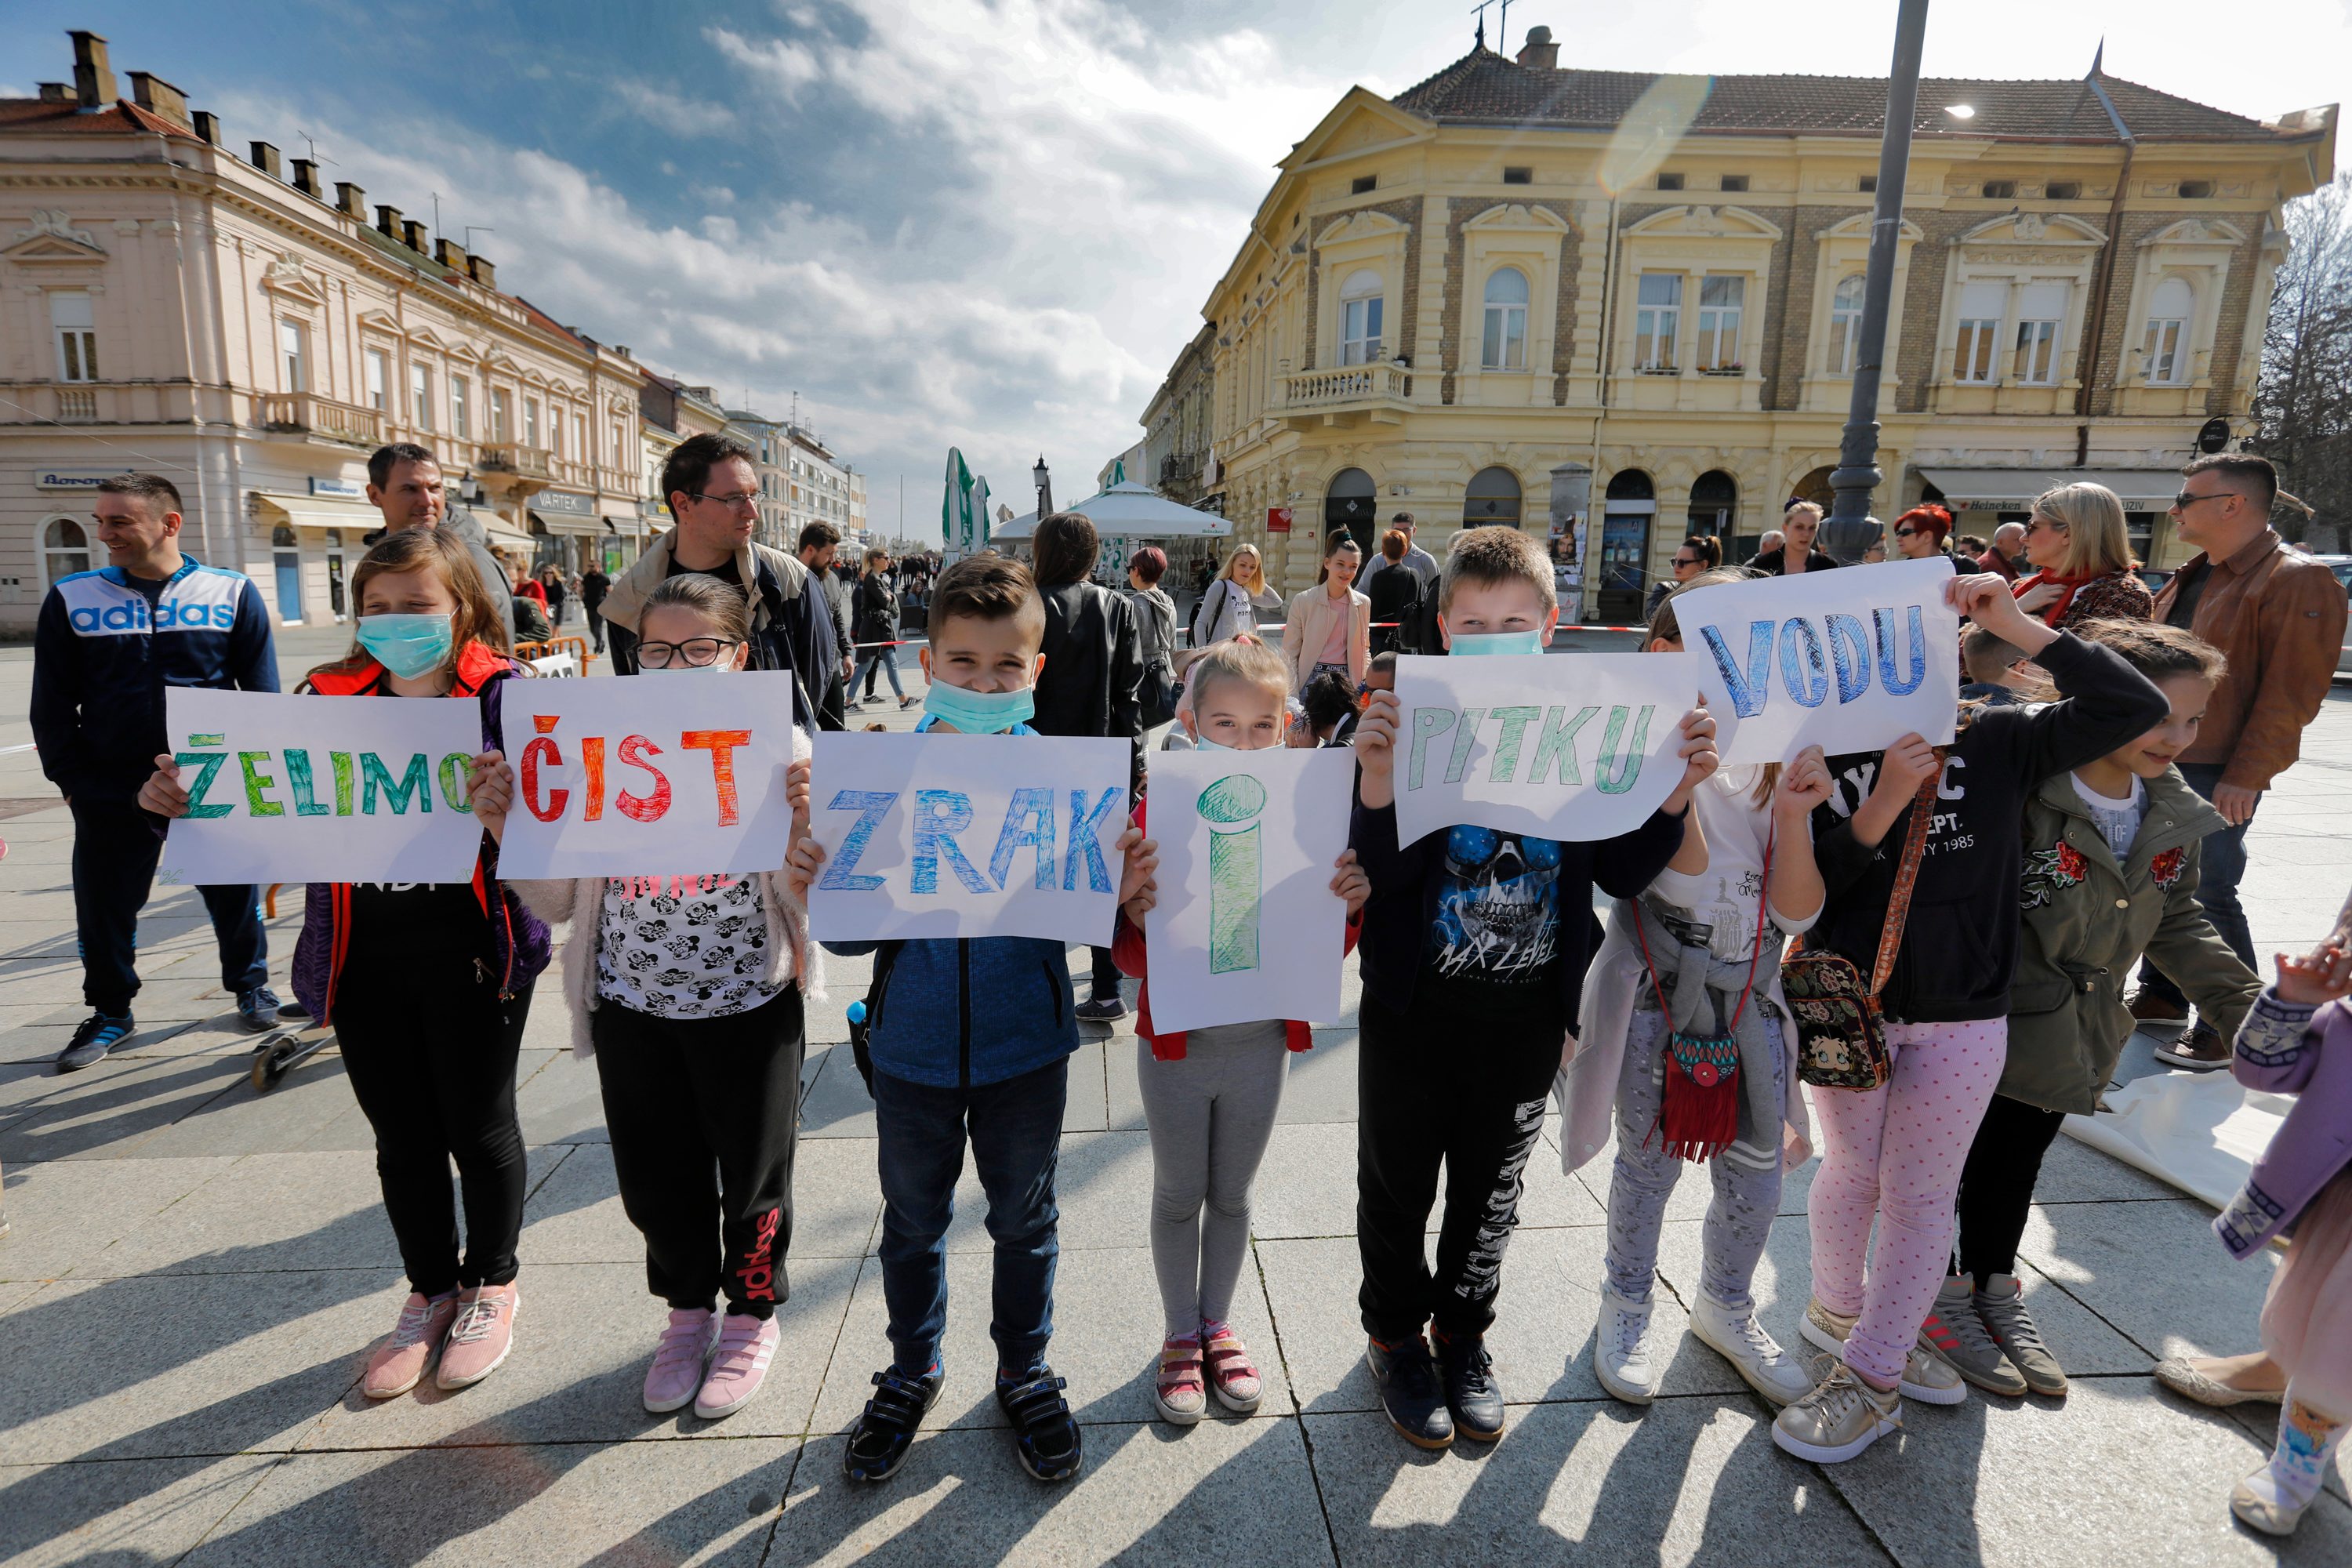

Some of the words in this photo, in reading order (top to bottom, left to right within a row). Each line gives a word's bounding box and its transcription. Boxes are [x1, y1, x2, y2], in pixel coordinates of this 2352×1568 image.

[1970, 501, 2020, 510] Heineken
[71, 598, 234, 632] adidas
[1699, 605, 1926, 719] VODU
[174, 733, 477, 818] ŽELIMO
[521, 714, 752, 827] ČIST
[1409, 706, 1656, 794] PITKU
[818, 787, 1124, 895] ZRAK
[1196, 774, 1269, 975] i
[1944, 835, 1974, 852] 1985
[1432, 935, 1497, 979] MAX
[1491, 935, 1558, 978] LEVEL
